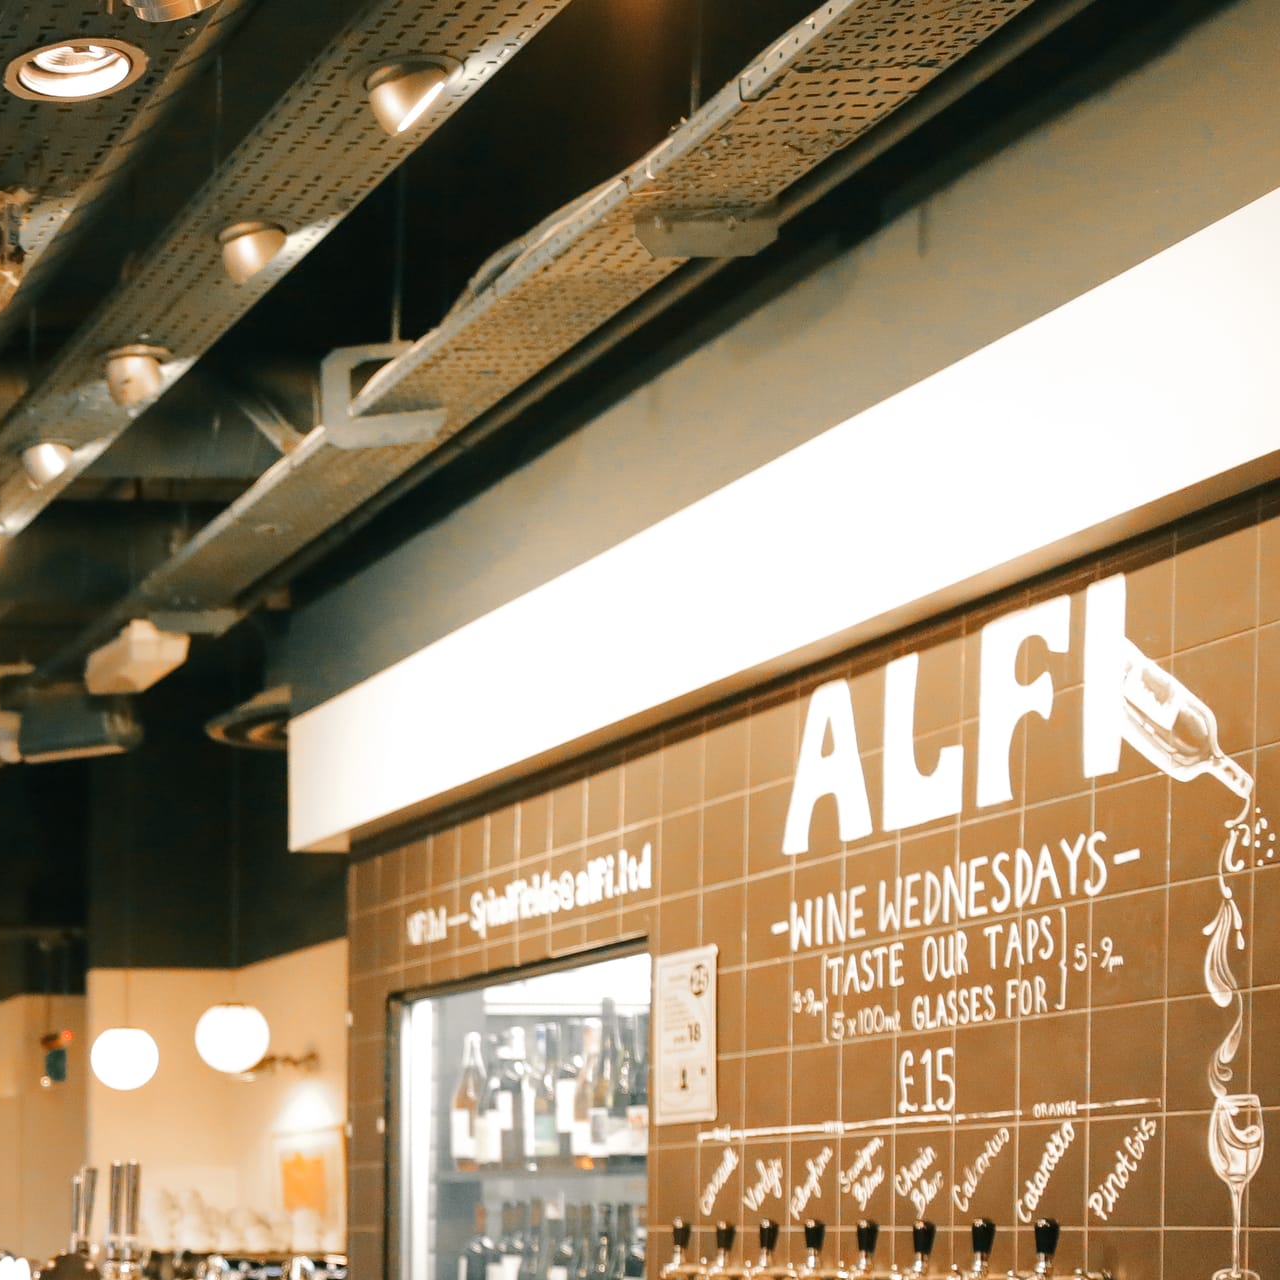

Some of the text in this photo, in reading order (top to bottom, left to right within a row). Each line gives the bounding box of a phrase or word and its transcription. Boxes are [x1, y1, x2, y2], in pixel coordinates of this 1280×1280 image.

[782, 573, 1126, 855] ALFI
[827, 915, 1055, 996] TASTE OUR TAPS
[911, 985, 996, 1032] GLASSES
[1005, 975, 1048, 1019] FOR
[898, 1047, 955, 1114] £15
[1032, 1100, 1077, 1118] ORANGE
[894, 1146, 937, 1197] Chenin
[1088, 1117, 1157, 1221] Pinot Gris
